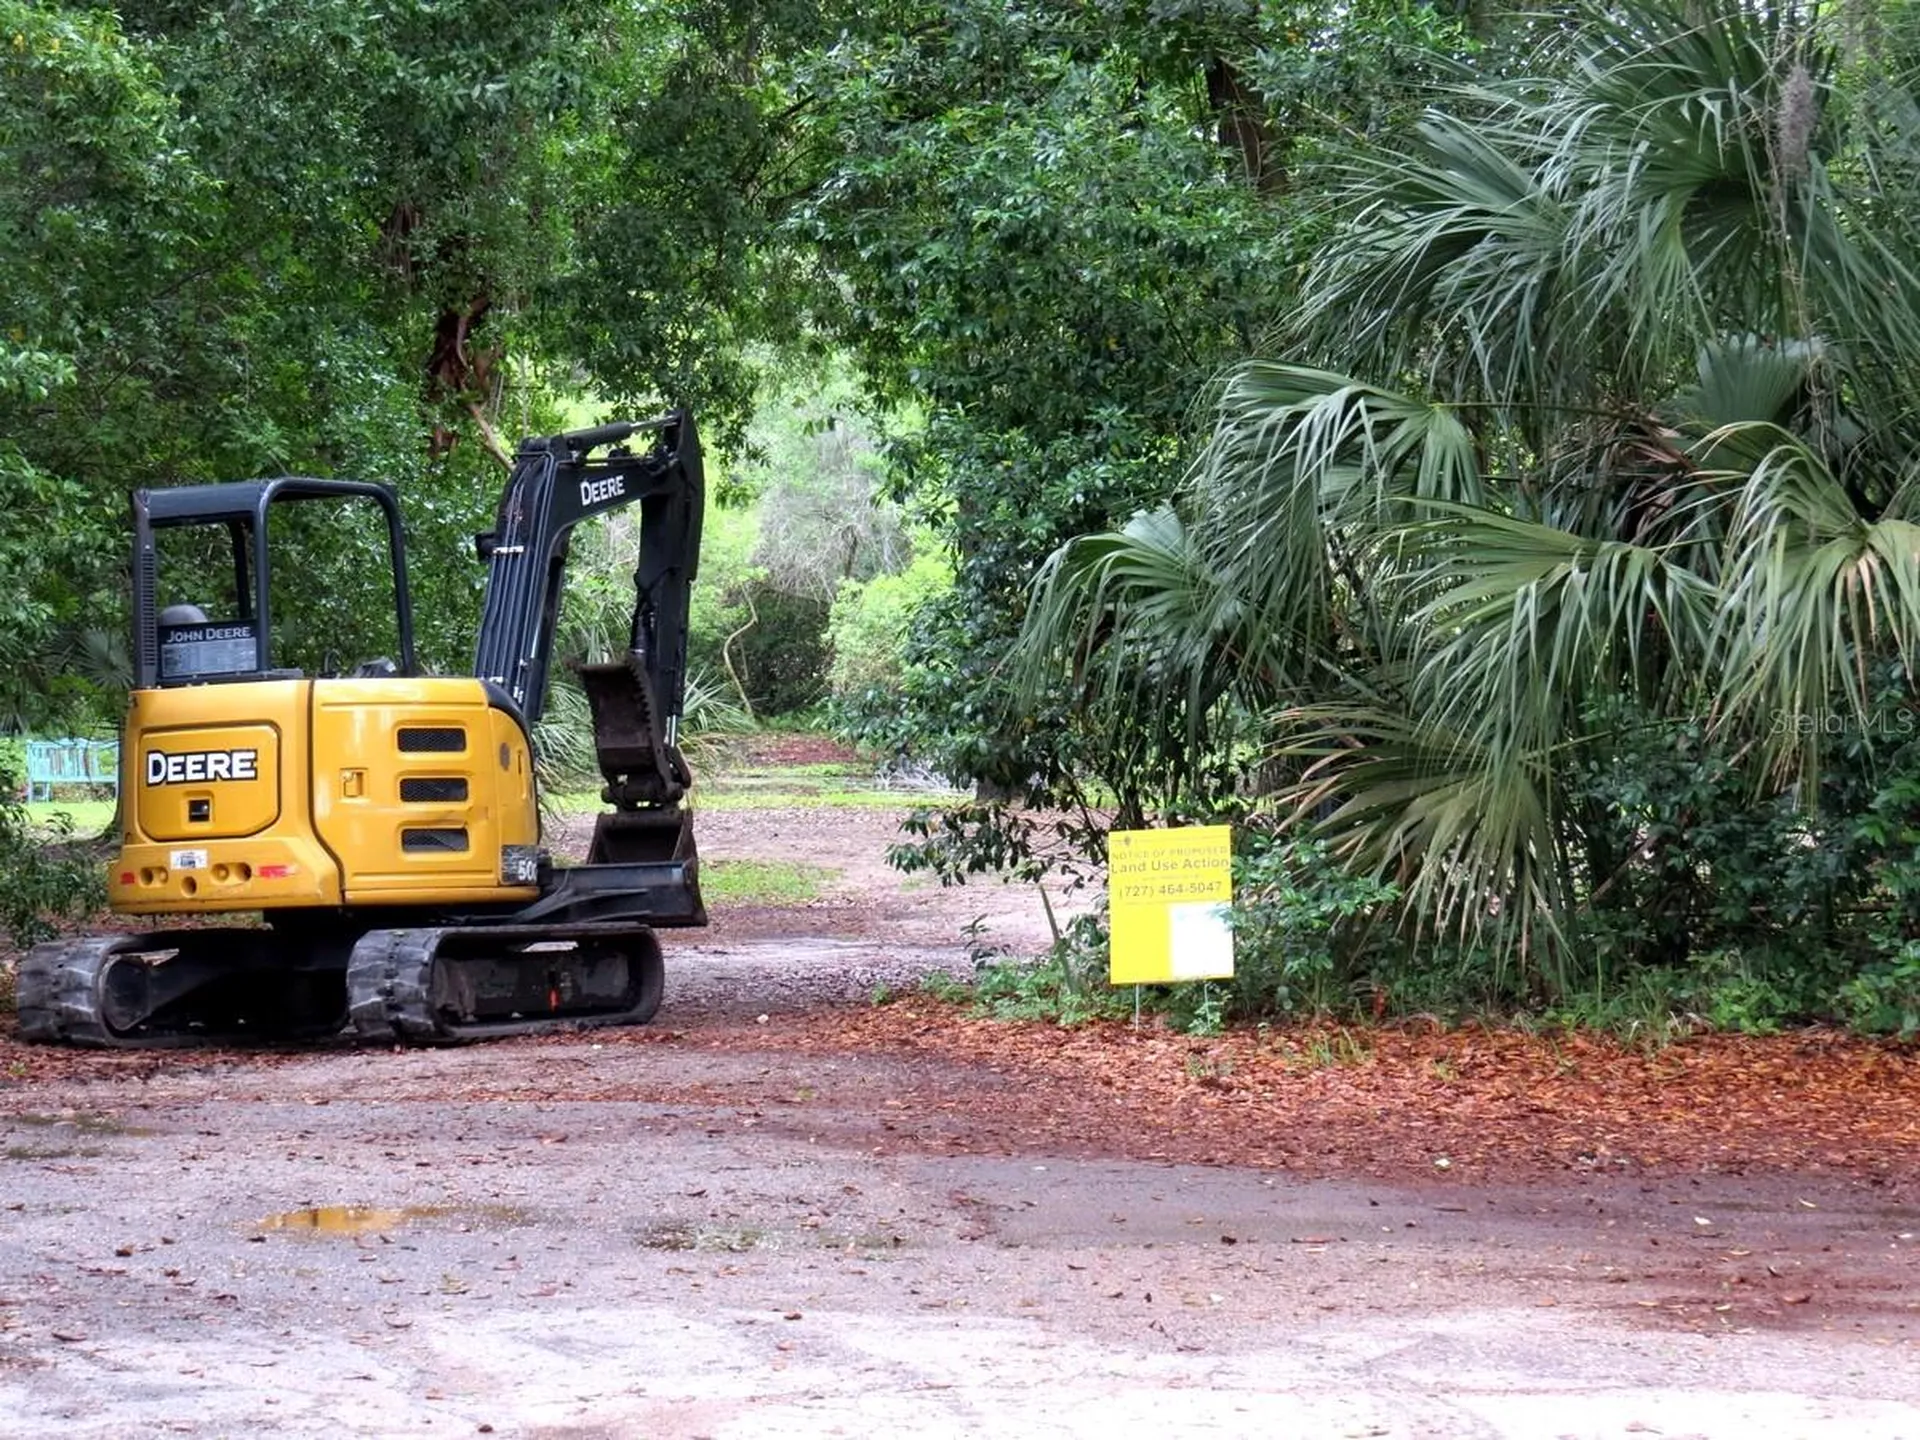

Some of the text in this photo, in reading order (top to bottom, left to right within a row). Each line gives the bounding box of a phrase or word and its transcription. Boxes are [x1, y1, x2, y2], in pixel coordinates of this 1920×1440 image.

[580, 474, 625, 506] DEERE
[167, 627, 250, 642] JOHN DEERE
[147, 750, 257, 785] DEERE
[1111, 850, 1149, 861] NOTICE
[1153, 849, 1166, 858] OF
[1112, 856, 1229, 874] Land Use Action
[1119, 881, 1222, 898] (727) 464-5047
